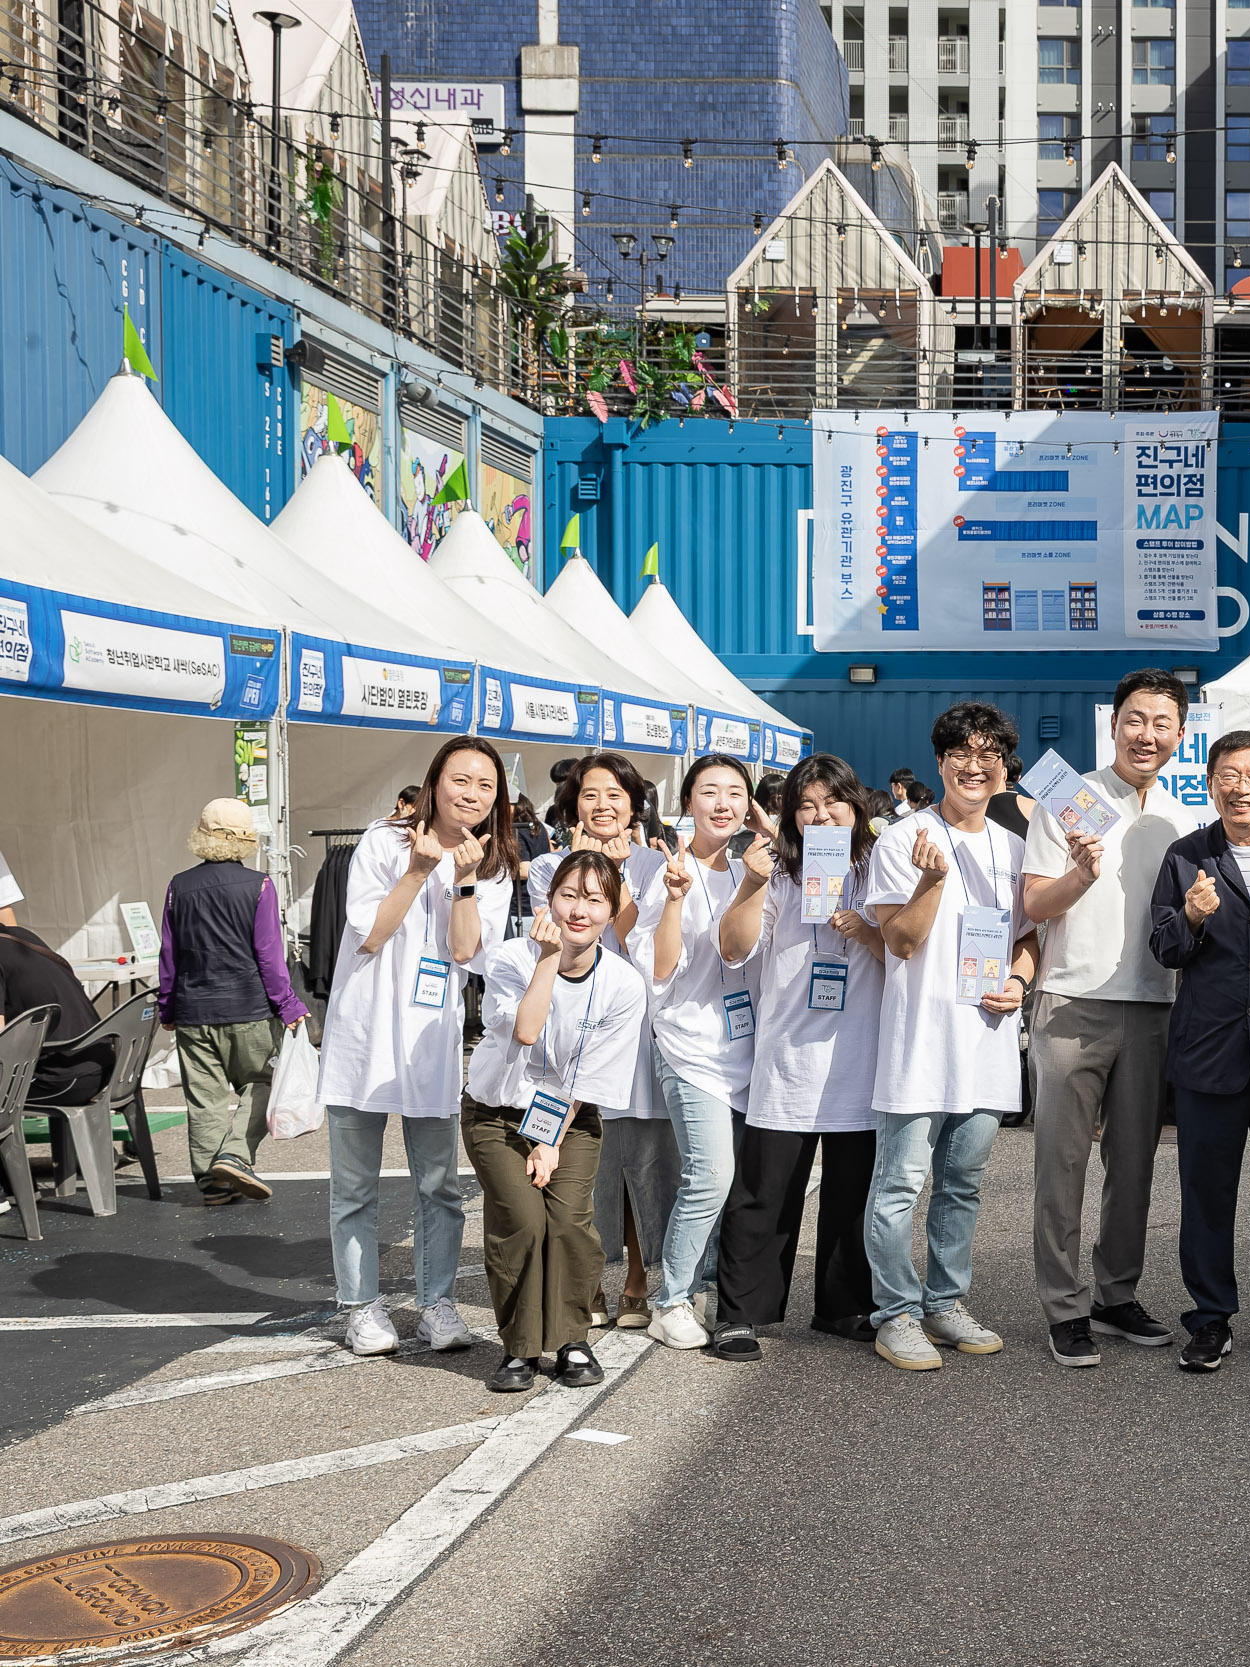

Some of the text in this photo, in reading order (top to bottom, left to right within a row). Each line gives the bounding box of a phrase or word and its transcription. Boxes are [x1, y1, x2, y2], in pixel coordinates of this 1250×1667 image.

[1136, 445, 1206, 469] 진구네
[1136, 474, 1205, 498] 편의점
[1137, 504, 1204, 529] MAP
[840, 465, 853, 600] 광진구 유관기관 부스
[106, 648, 221, 680] 청년취업사관학교 새싹(SeSAC)
[361, 684, 429, 711] 사단법인 열린옷장
[422, 989, 438, 998] STAFF
[817, 993, 837, 1001] STAFF
[735, 1021, 750, 1030] STAFF
[531, 1123, 551, 1135] STAFF
[75, 1586, 141, 1627] GROUND
[108, 1578, 177, 1619] COMMON
